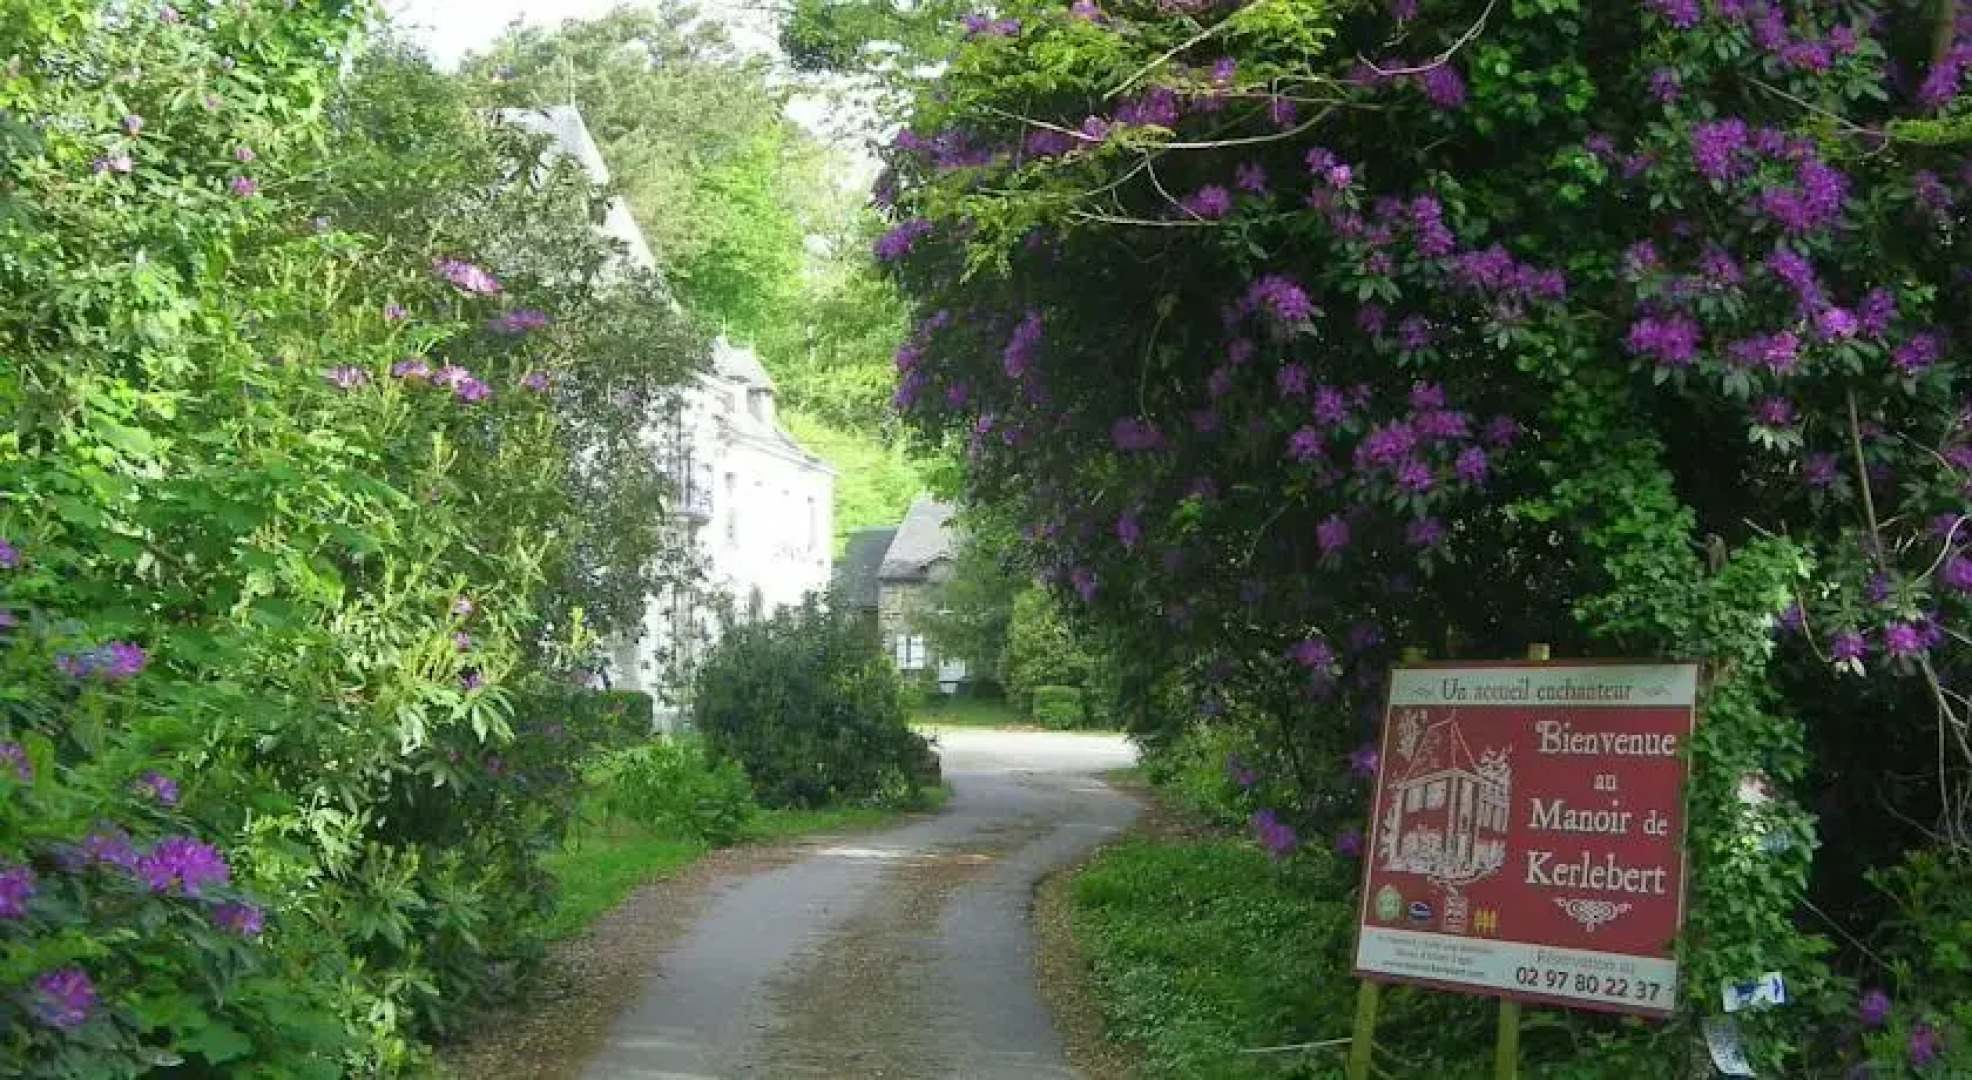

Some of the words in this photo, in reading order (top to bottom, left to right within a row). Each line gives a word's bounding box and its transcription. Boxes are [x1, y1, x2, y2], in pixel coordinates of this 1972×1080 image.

[1443, 678, 1466, 701] Un
[1473, 676, 1529, 701] accueil
[1537, 679, 1632, 701] enchanteur
[1535, 720, 1677, 756] Bienvenue
[1593, 774, 1618, 791] au
[1527, 797, 1632, 834] Manoir
[1643, 809, 1669, 836] de
[1525, 850, 1667, 894] Kerlebert
[1516, 966, 1539, 986] 02
[1546, 969, 1569, 989] 97
[1574, 973, 1600, 993] 80
[1605, 978, 1628, 997] 22
[1635, 980, 1661, 1000] 37
